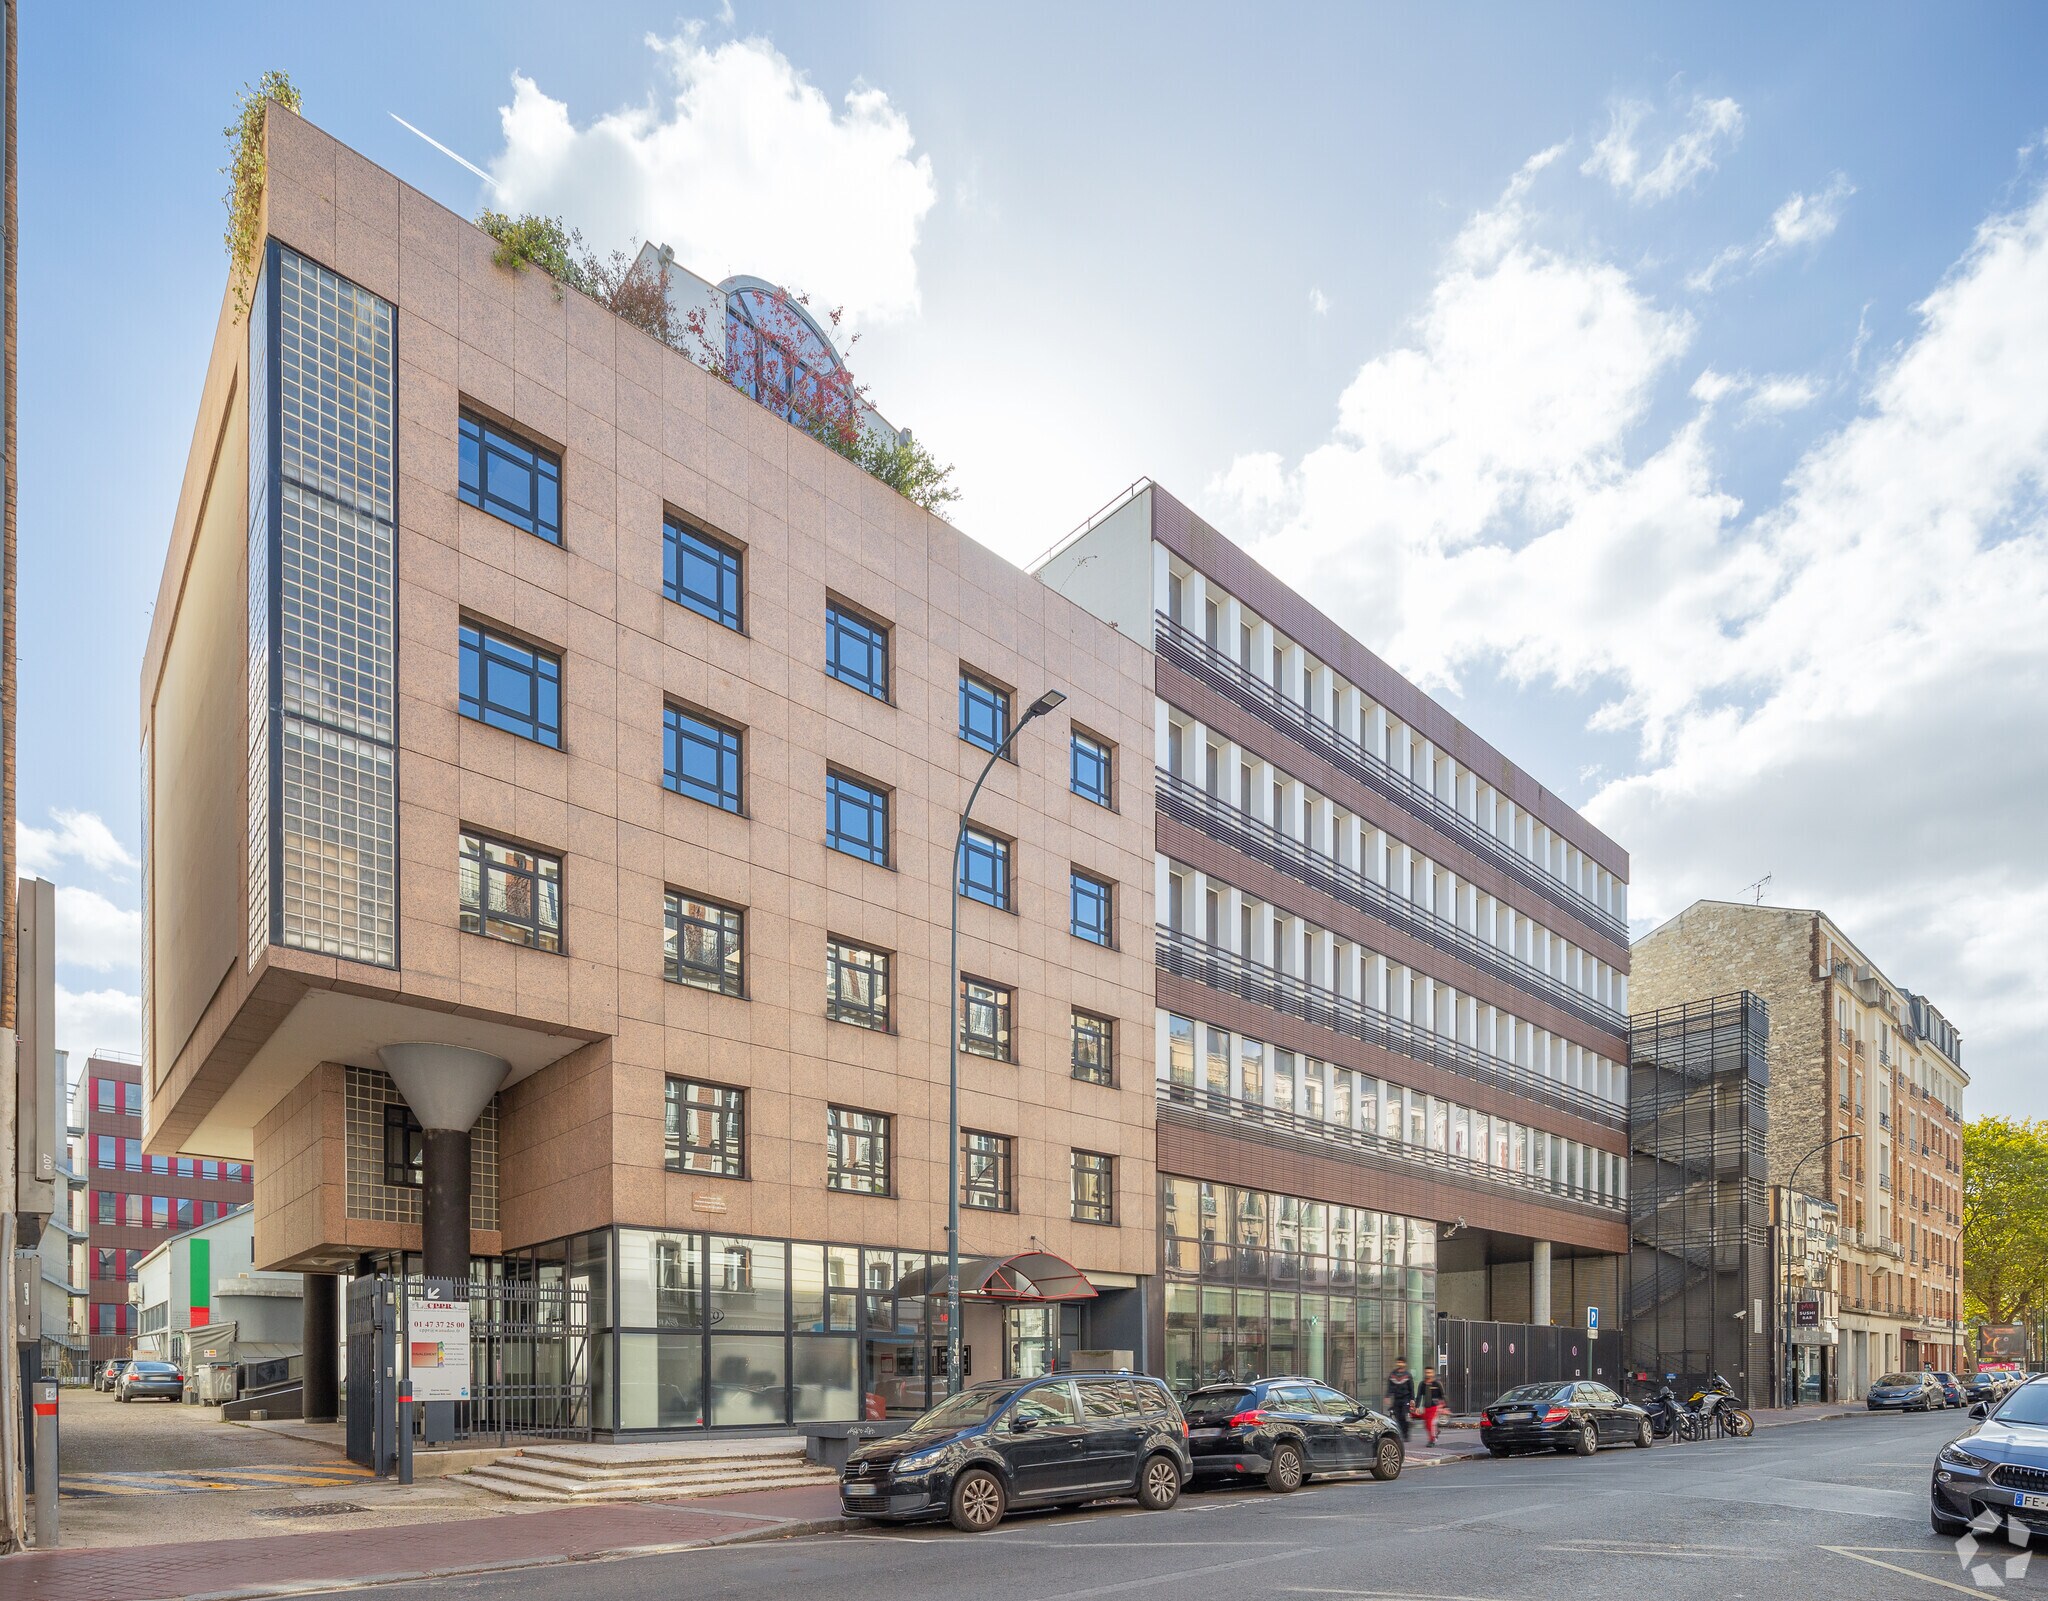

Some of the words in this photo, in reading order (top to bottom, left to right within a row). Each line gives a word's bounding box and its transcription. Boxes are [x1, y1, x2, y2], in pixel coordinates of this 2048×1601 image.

[43, 1153, 52, 1170] 007
[1591, 1311, 1596, 1325] P
[216, 1373, 232, 1393] 16
[2024, 1496, 2048, 1507] FE-
